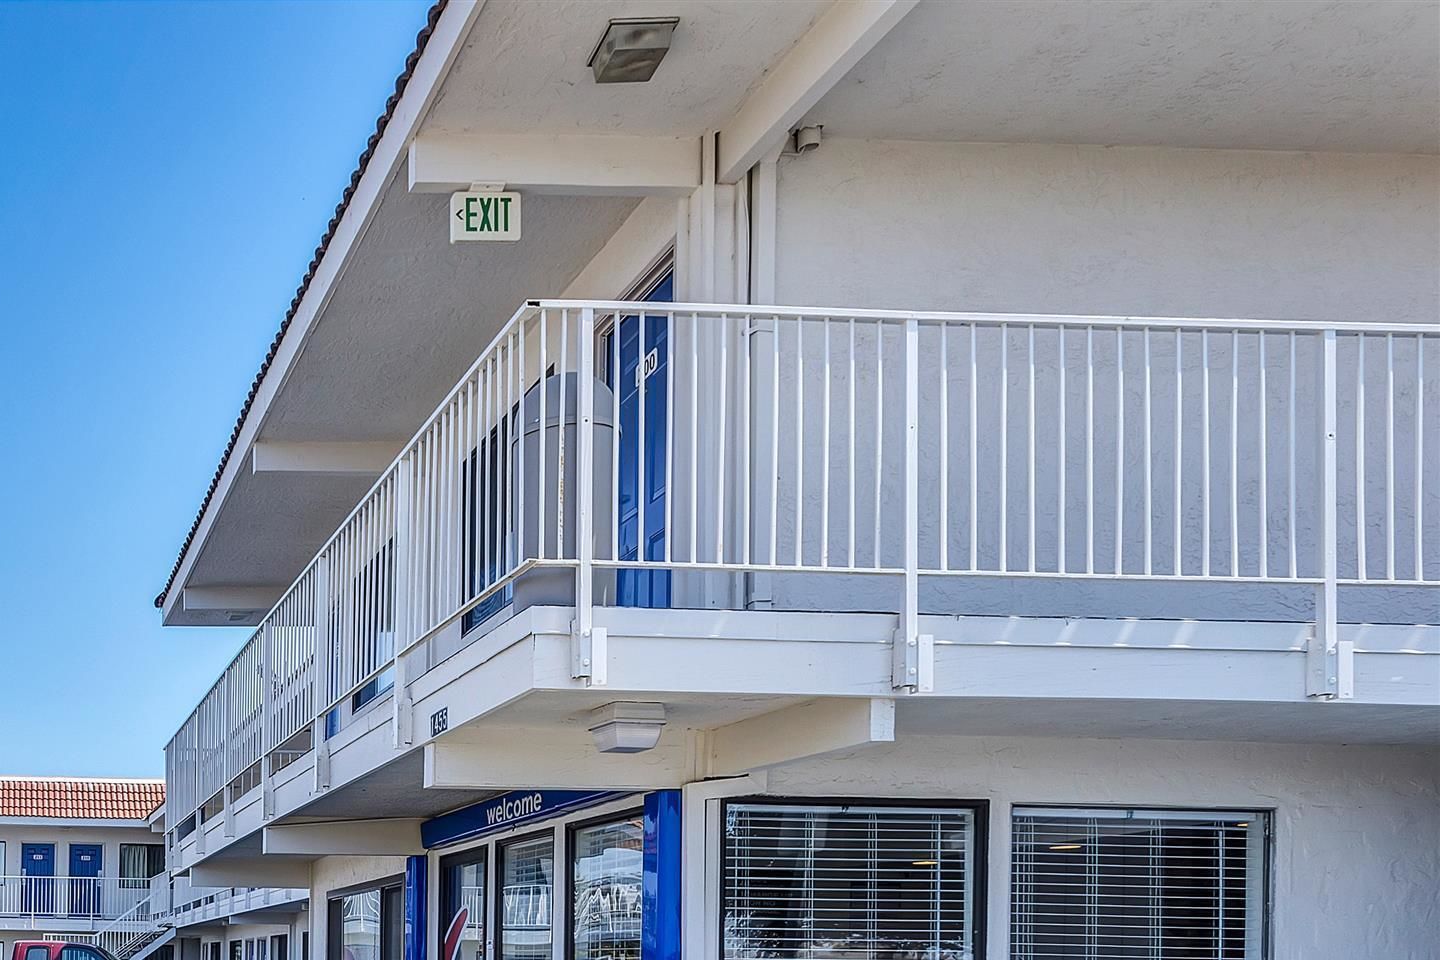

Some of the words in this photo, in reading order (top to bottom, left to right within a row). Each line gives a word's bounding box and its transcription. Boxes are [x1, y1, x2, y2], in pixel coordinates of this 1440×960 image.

[465, 197, 512, 232] EXIT
[431, 708, 448, 737] 1455
[486, 792, 543, 825] welcome
